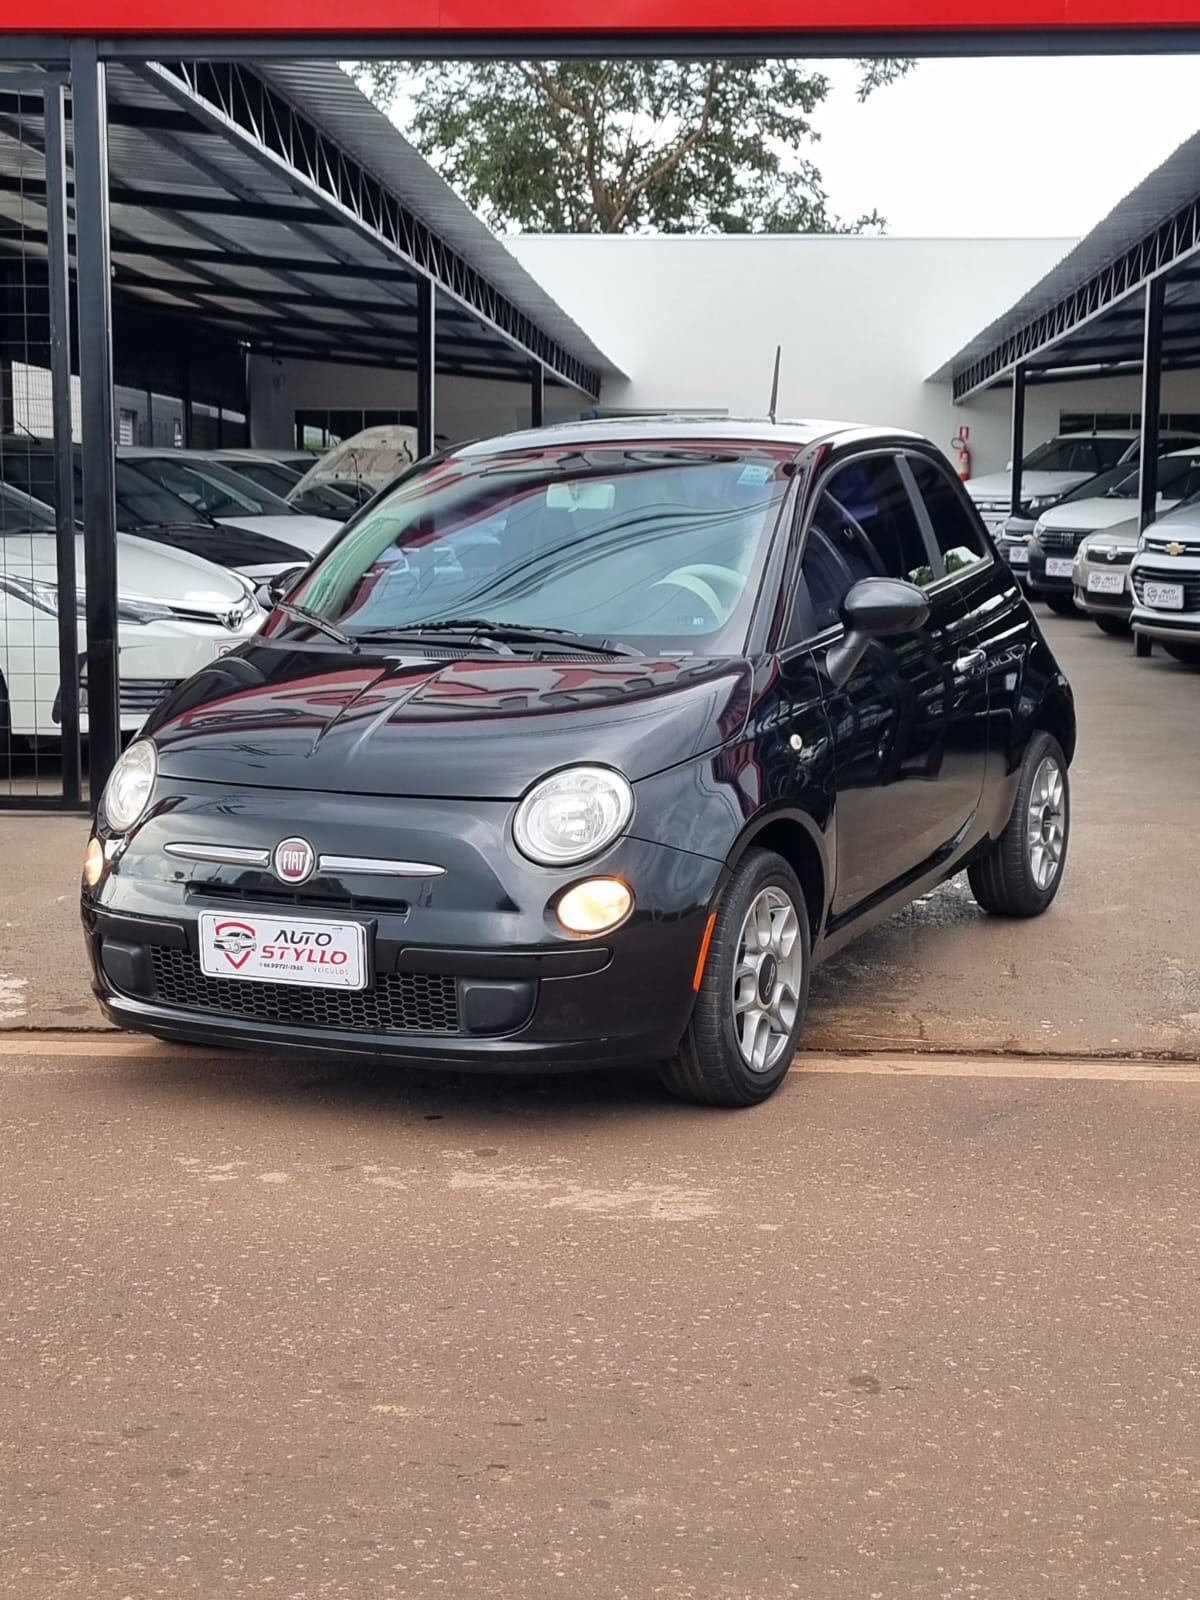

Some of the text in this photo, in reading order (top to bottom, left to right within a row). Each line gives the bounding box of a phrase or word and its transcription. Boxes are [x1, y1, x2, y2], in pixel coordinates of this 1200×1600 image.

[283, 850, 306, 871] FIAT
[274, 929, 332, 947] AUTO
[260, 945, 348, 965] STYLLO
